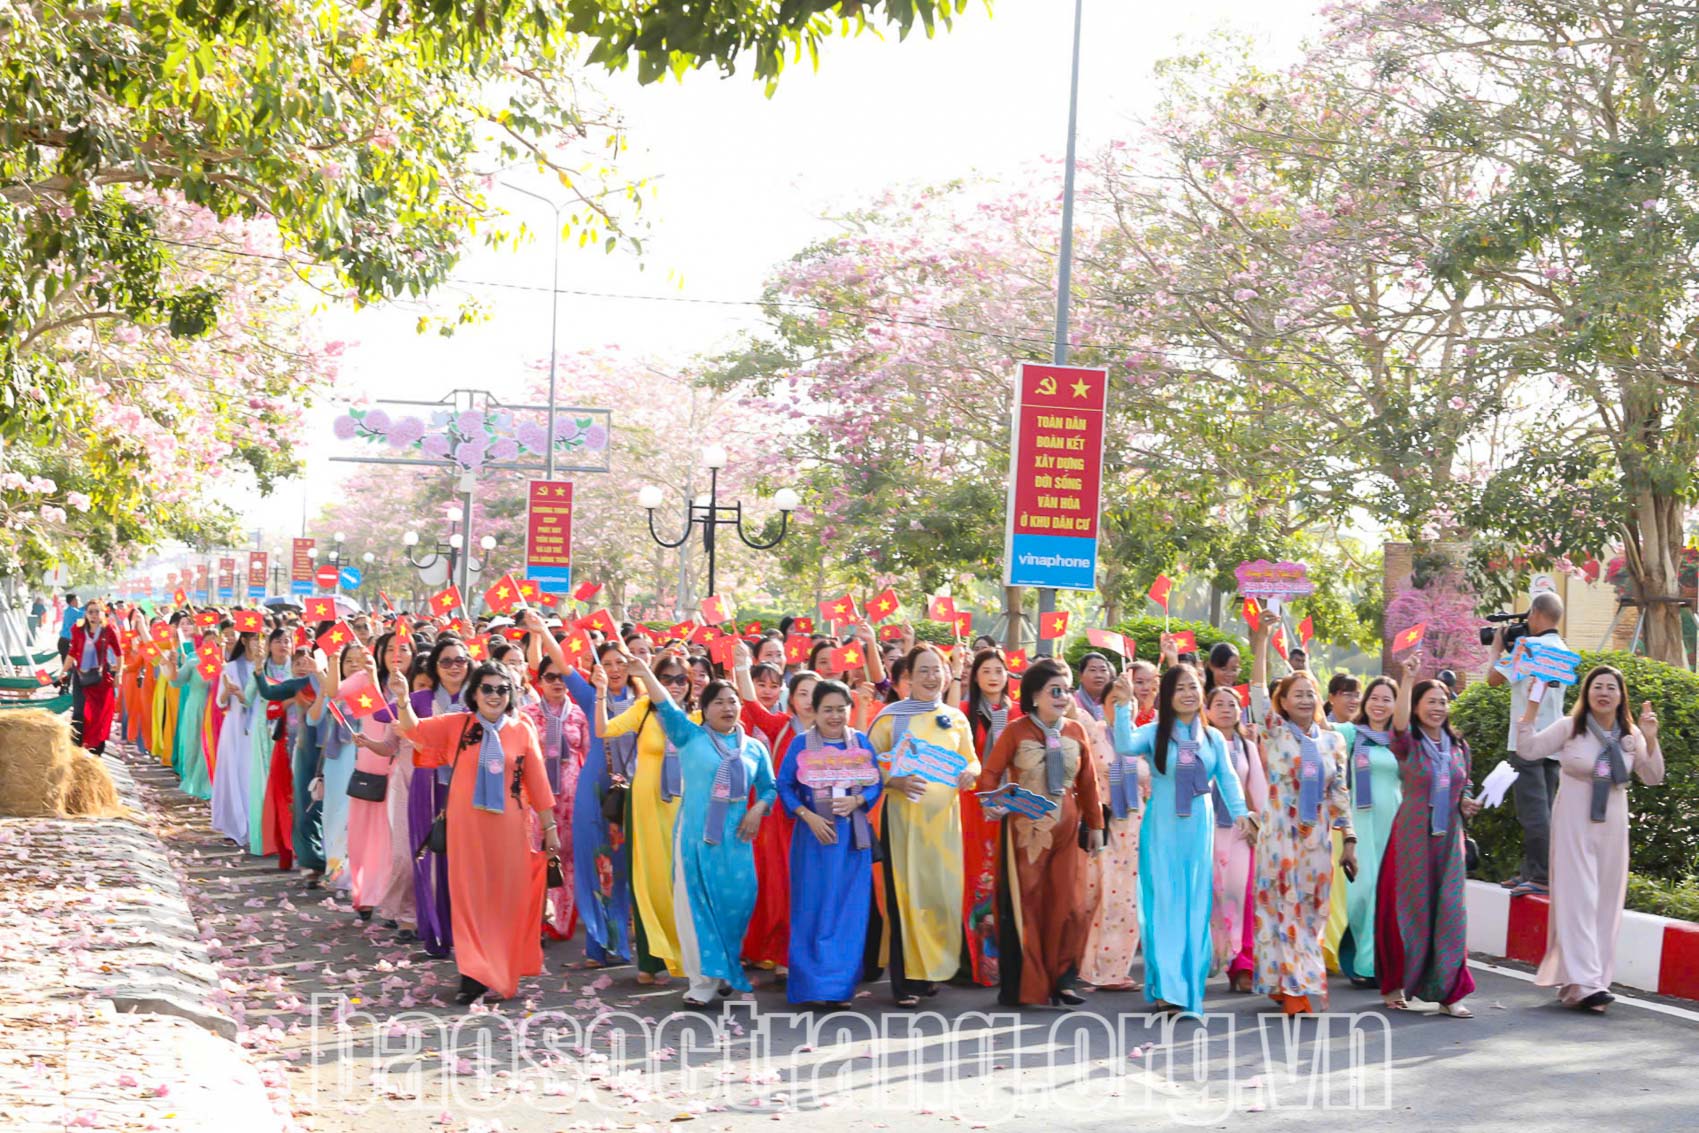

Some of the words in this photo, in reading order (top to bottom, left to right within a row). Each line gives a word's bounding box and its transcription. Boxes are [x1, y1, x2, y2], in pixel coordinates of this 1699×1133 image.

[1037, 414, 1063, 428] TOÀN
[1065, 416, 1086, 430] DÂN
[1036, 434, 1064, 449] ĐOÀN
[1066, 435, 1085, 450] KẾT
[1035, 453, 1055, 468] XÂY
[1057, 457, 1084, 472] DỰNG
[1055, 474, 1082, 490] SỐNG
[1038, 494, 1058, 508] VĂN
[1021, 511, 1028, 526] Ở
[1030, 515, 1050, 528] KHU
[1053, 515, 1074, 529] DÂN
[1076, 517, 1090, 530] CƯ
[1019, 552, 1090, 568] vinaphone
